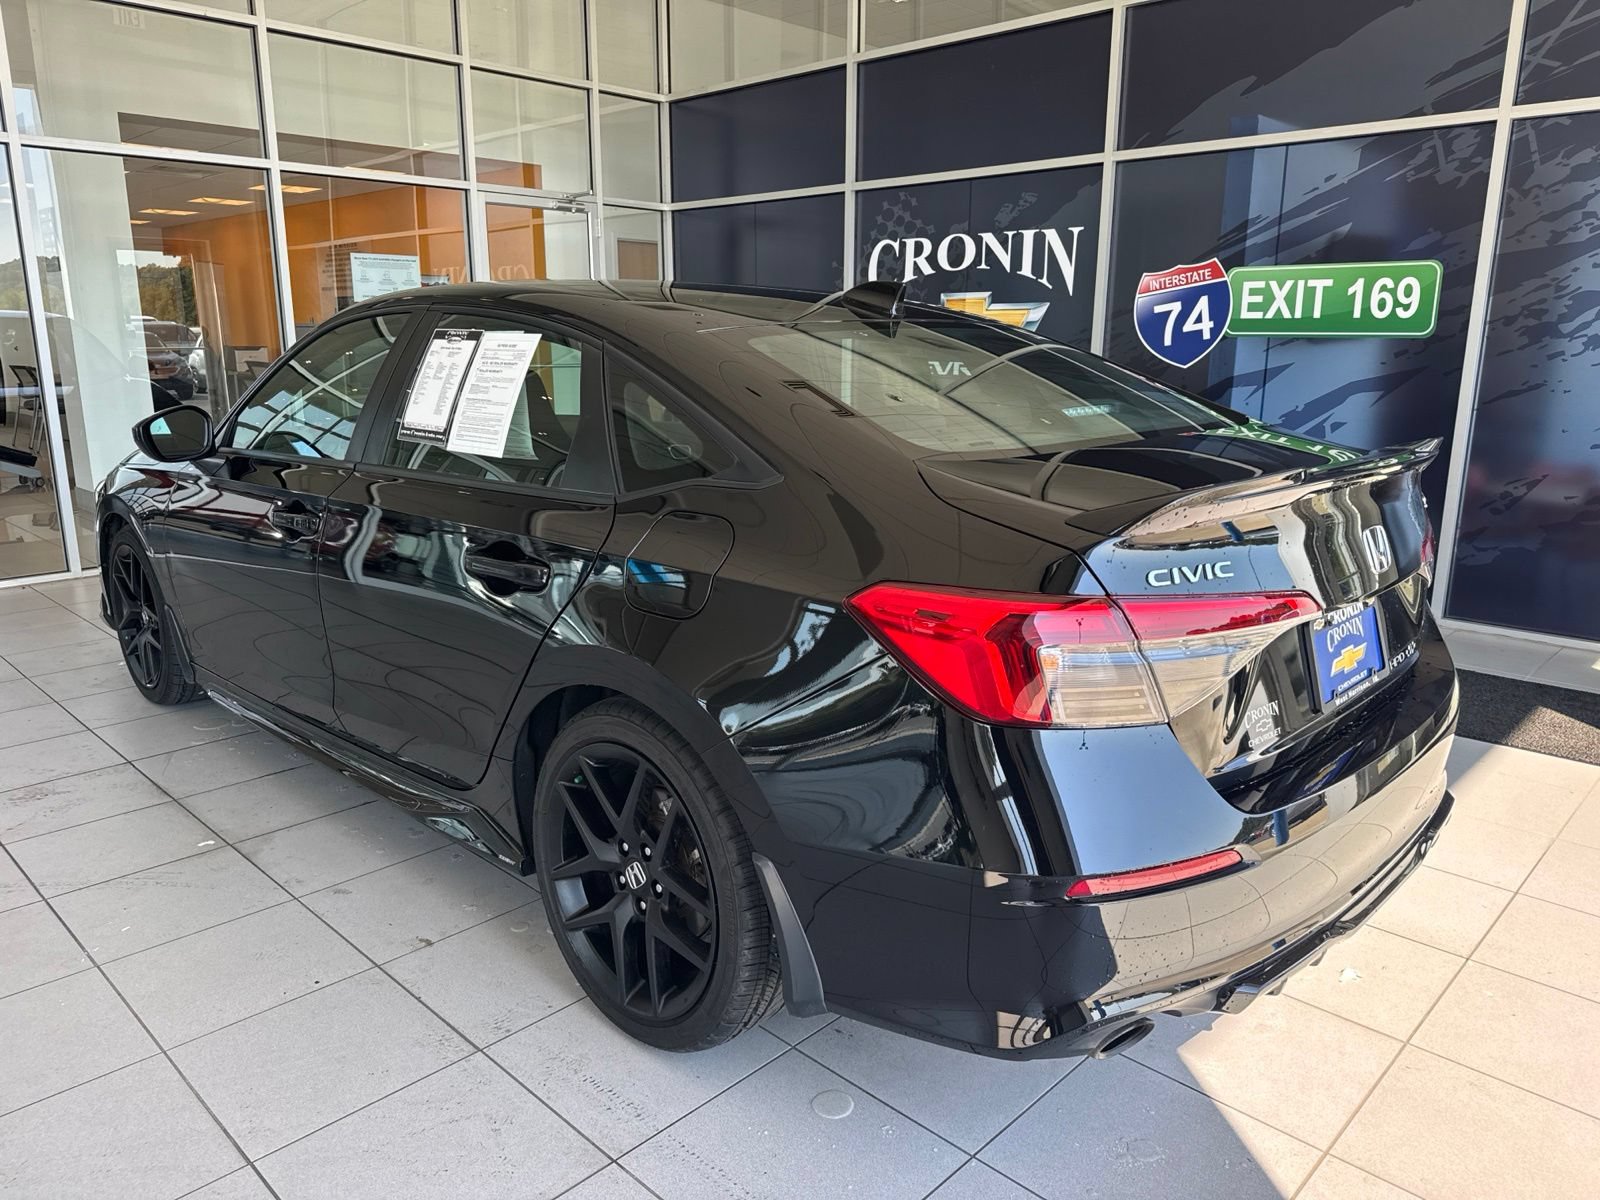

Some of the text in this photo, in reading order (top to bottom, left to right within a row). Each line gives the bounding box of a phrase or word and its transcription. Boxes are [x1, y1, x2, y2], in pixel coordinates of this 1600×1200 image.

[868, 226, 1085, 297] CRONIN
[1149, 268, 1213, 292] INTERSTATE
[1239, 275, 1421, 320] EXIT 169
[1153, 294, 1215, 347] 74
[1146, 561, 1235, 588] CIVIC
[1327, 601, 1364, 625] CRONIN
[1326, 615, 1365, 653] CRONIN
[1337, 669, 1367, 692] CHEVROLET
[1244, 700, 1280, 729] CRONIN
[1248, 727, 1281, 748] CHEVROLET
